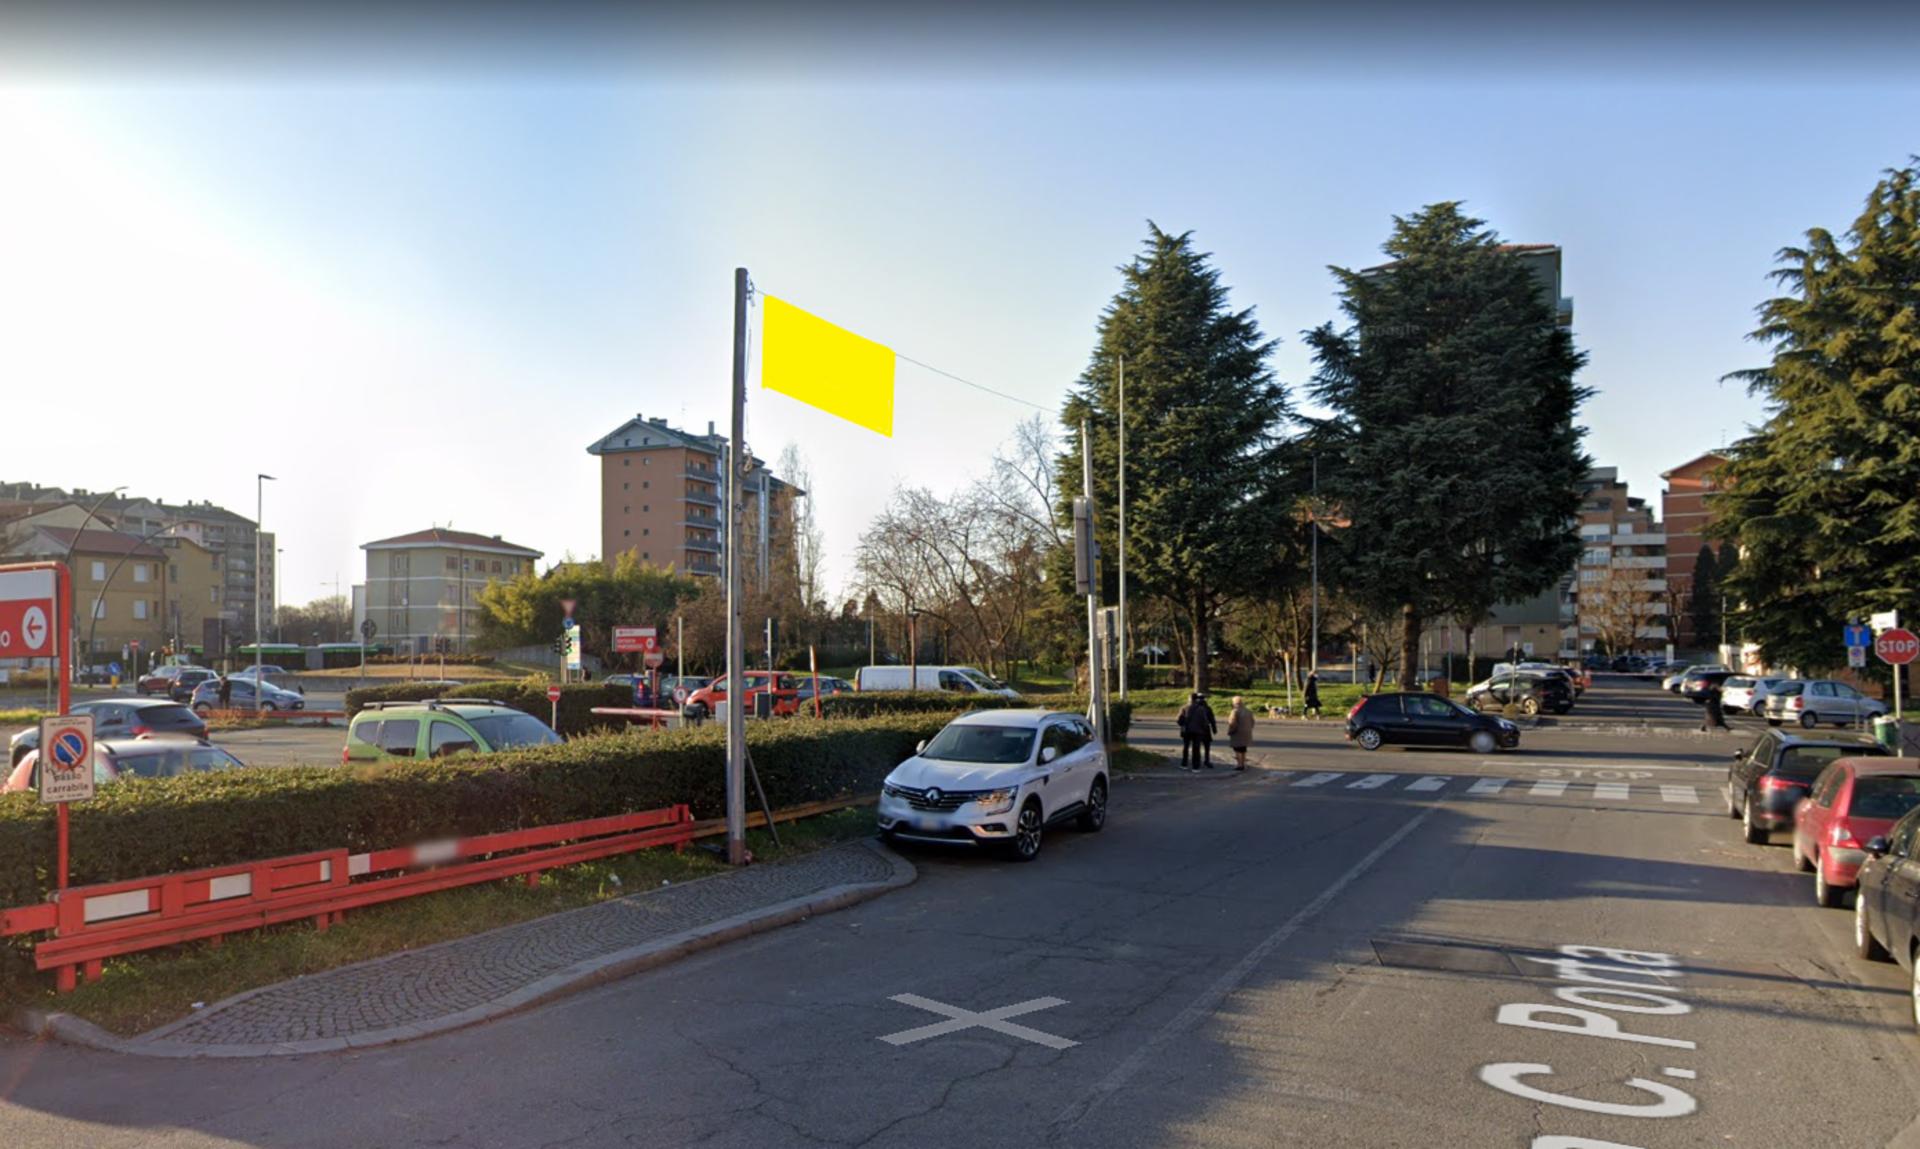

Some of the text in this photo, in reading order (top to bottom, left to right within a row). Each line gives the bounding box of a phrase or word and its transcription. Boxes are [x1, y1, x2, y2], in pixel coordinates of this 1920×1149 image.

[1878, 640, 1917, 653] STOP
[1539, 768, 1654, 780] STOP
[46, 783, 89, 794] carrabile
[1496, 944, 1697, 1050] Porta
[1479, 1062, 1697, 1118] C.
